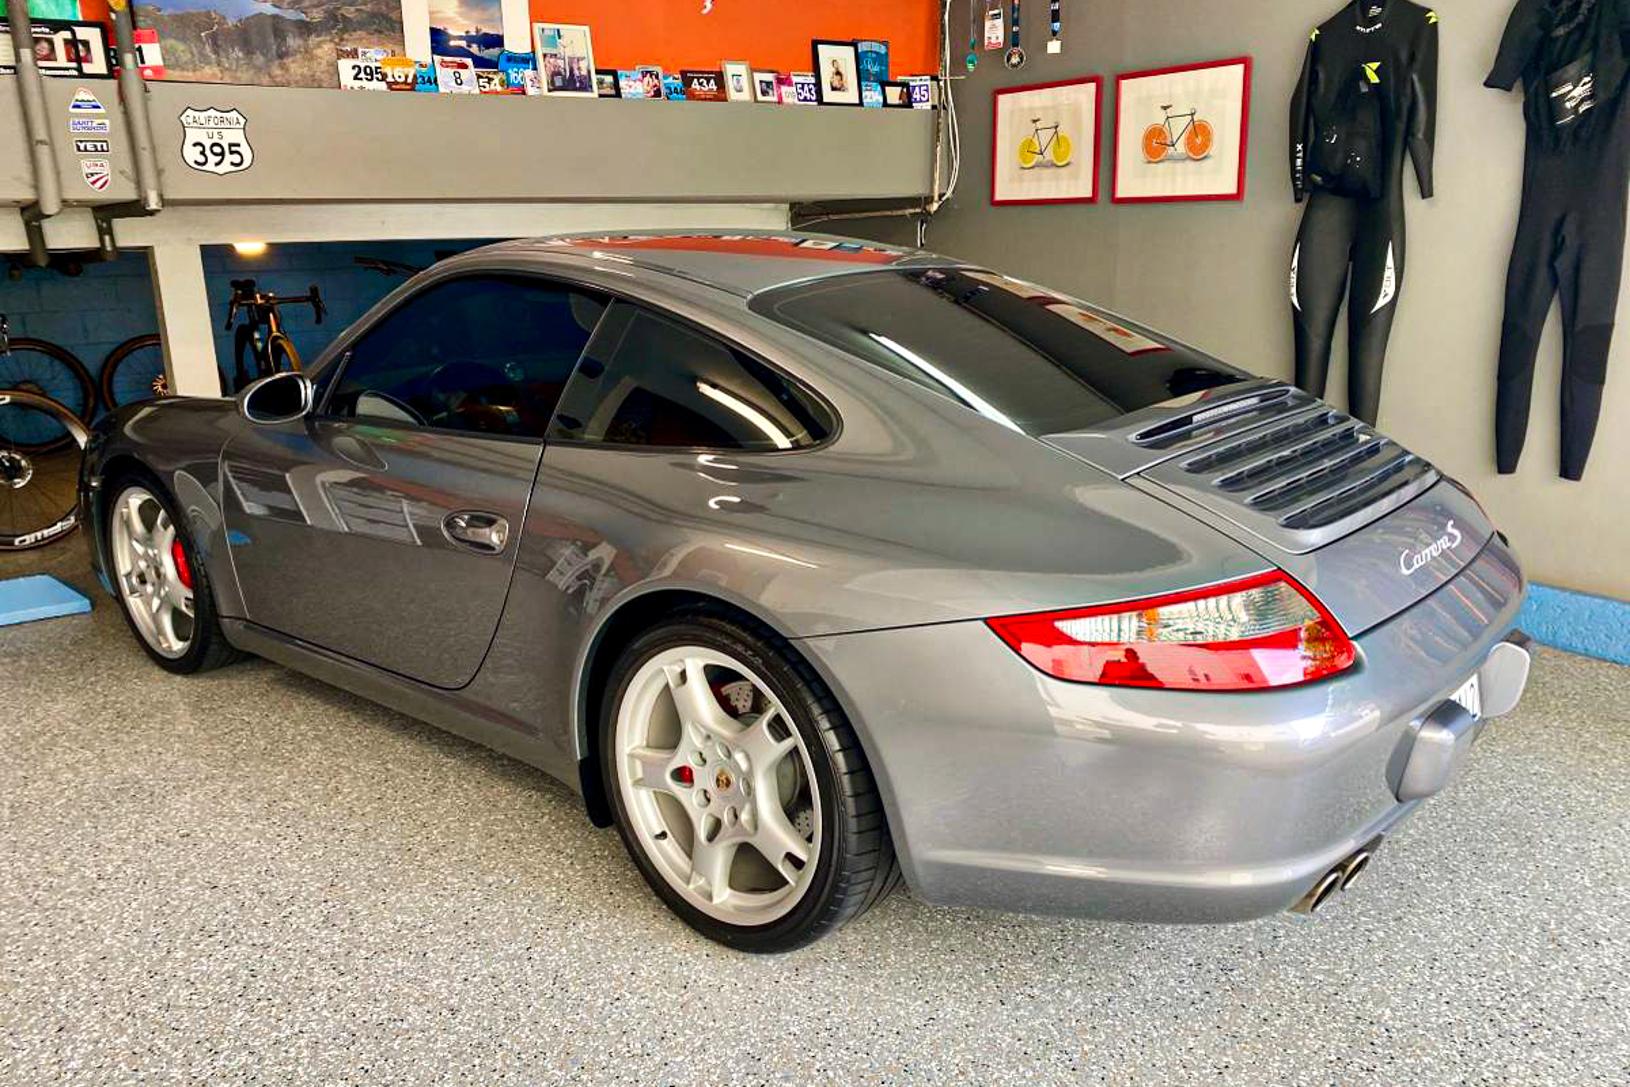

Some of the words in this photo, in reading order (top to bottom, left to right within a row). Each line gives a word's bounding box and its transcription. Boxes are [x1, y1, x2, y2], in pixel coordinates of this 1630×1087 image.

[352, 64, 383, 82] 295
[386, 66, 415, 83] 167
[453, 71, 463, 86] 8
[691, 78, 718, 91] 434
[796, 83, 816, 101] 543
[185, 115, 242, 126] CALIFORNIA
[206, 131, 224, 140] US
[77, 142, 108, 152] YETI
[192, 141, 244, 167] 395
[1400, 535, 1451, 576] Carrera
[1447, 519, 1462, 549] S
